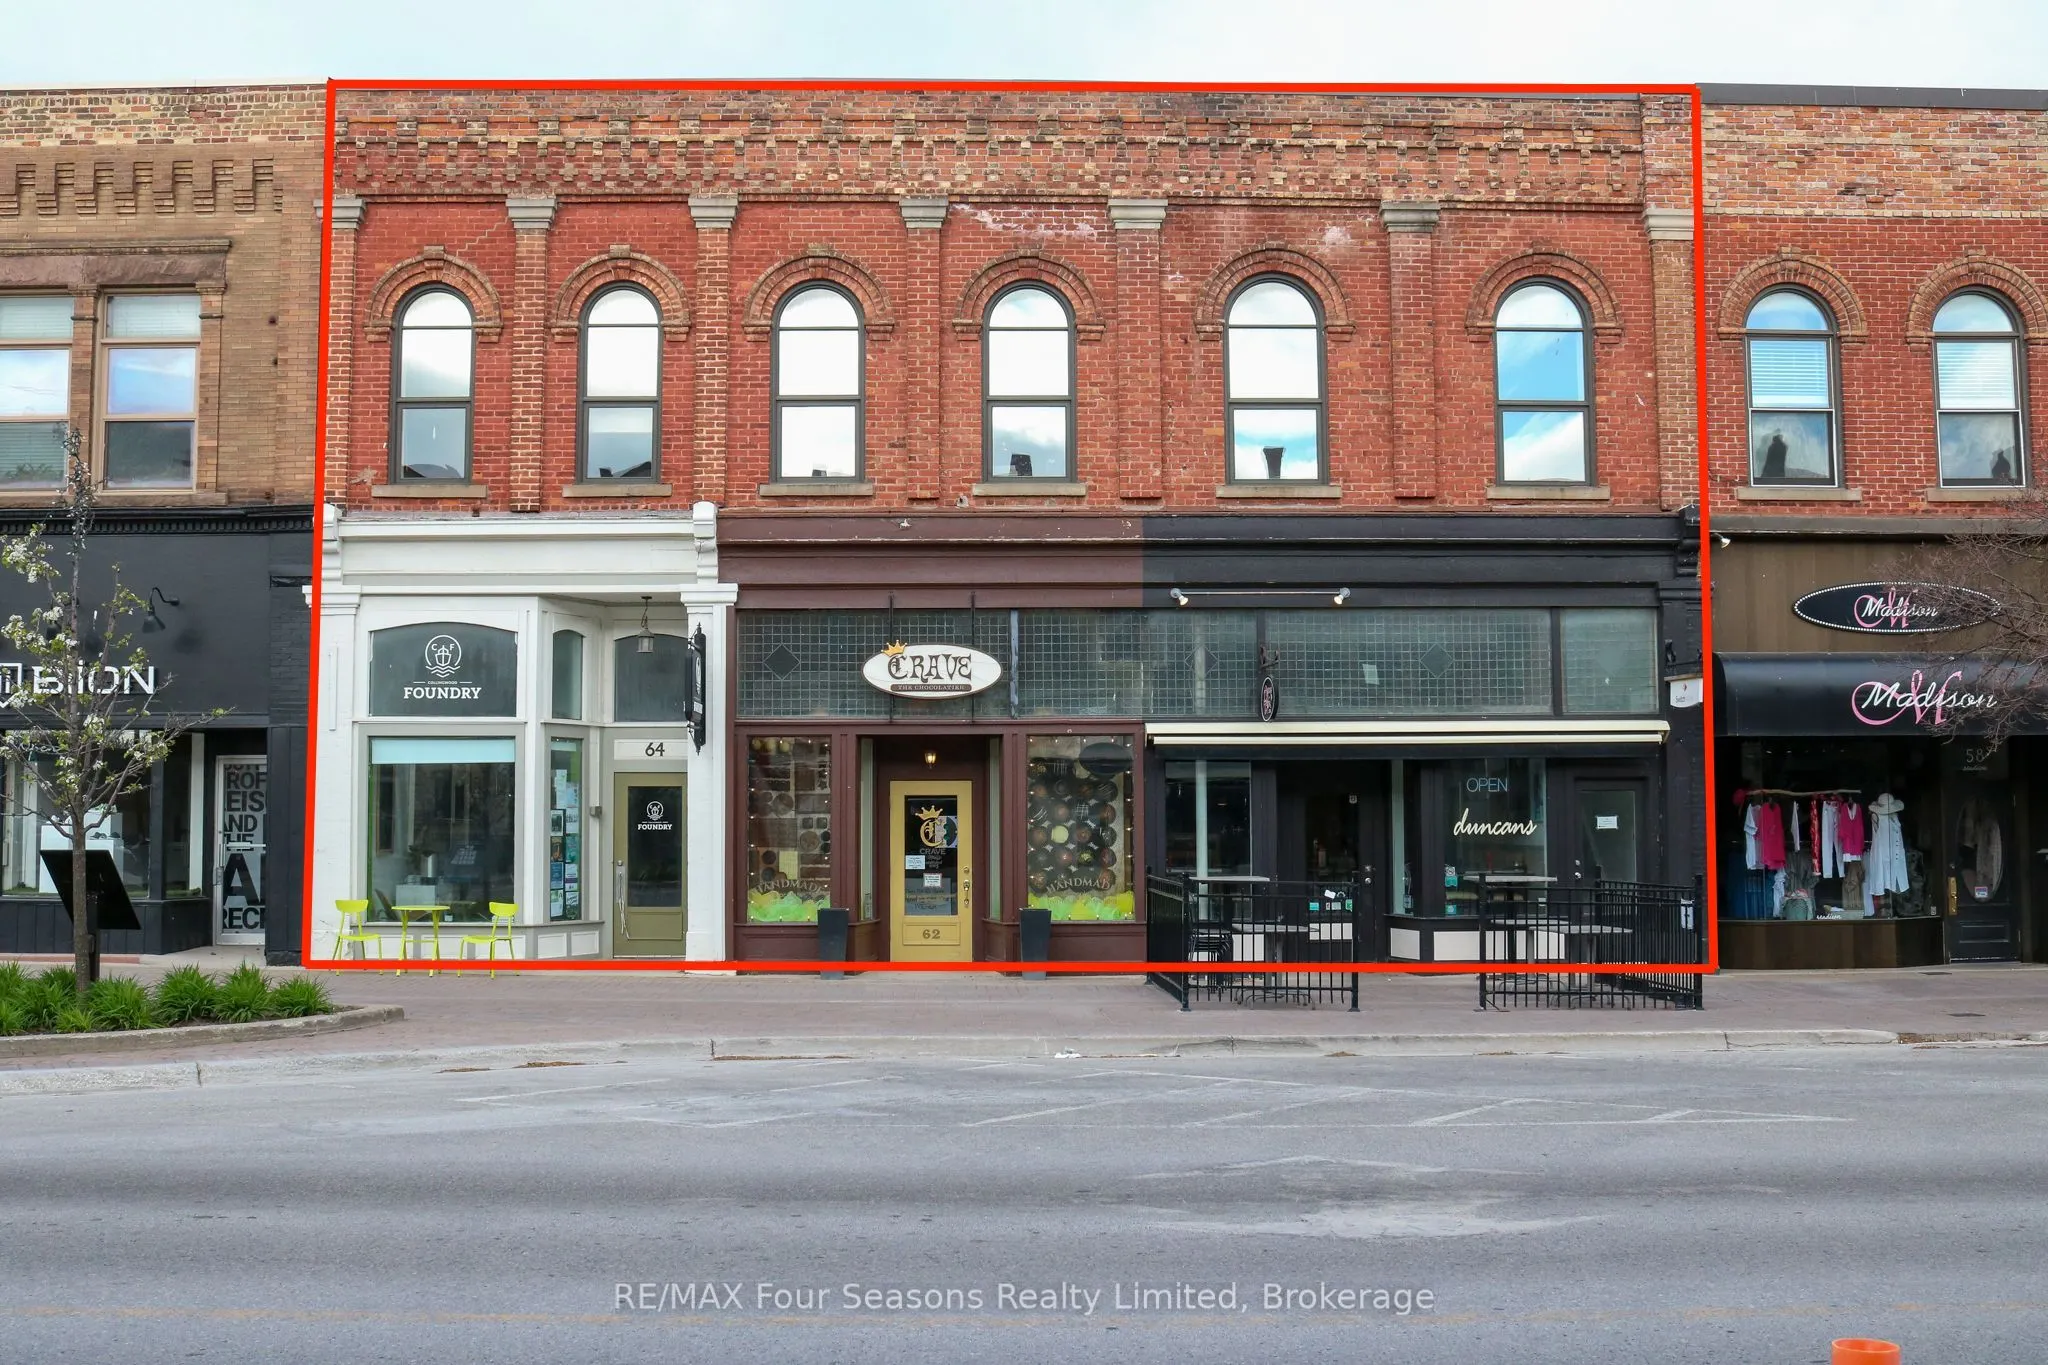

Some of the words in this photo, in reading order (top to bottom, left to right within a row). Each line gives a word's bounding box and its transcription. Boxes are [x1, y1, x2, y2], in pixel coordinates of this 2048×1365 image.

[1861, 597, 1937, 618] Madison
[887, 653, 972, 683] CRAVE
[403, 687, 482, 699] FOUNDRY
[1861, 682, 1998, 708] Madison
[645, 742, 665, 757] 64
[1966, 748, 1983, 763] 58
[1466, 777, 1508, 792] OPEN
[1453, 808, 1537, 836] duncans
[922, 928, 941, 939] 62
